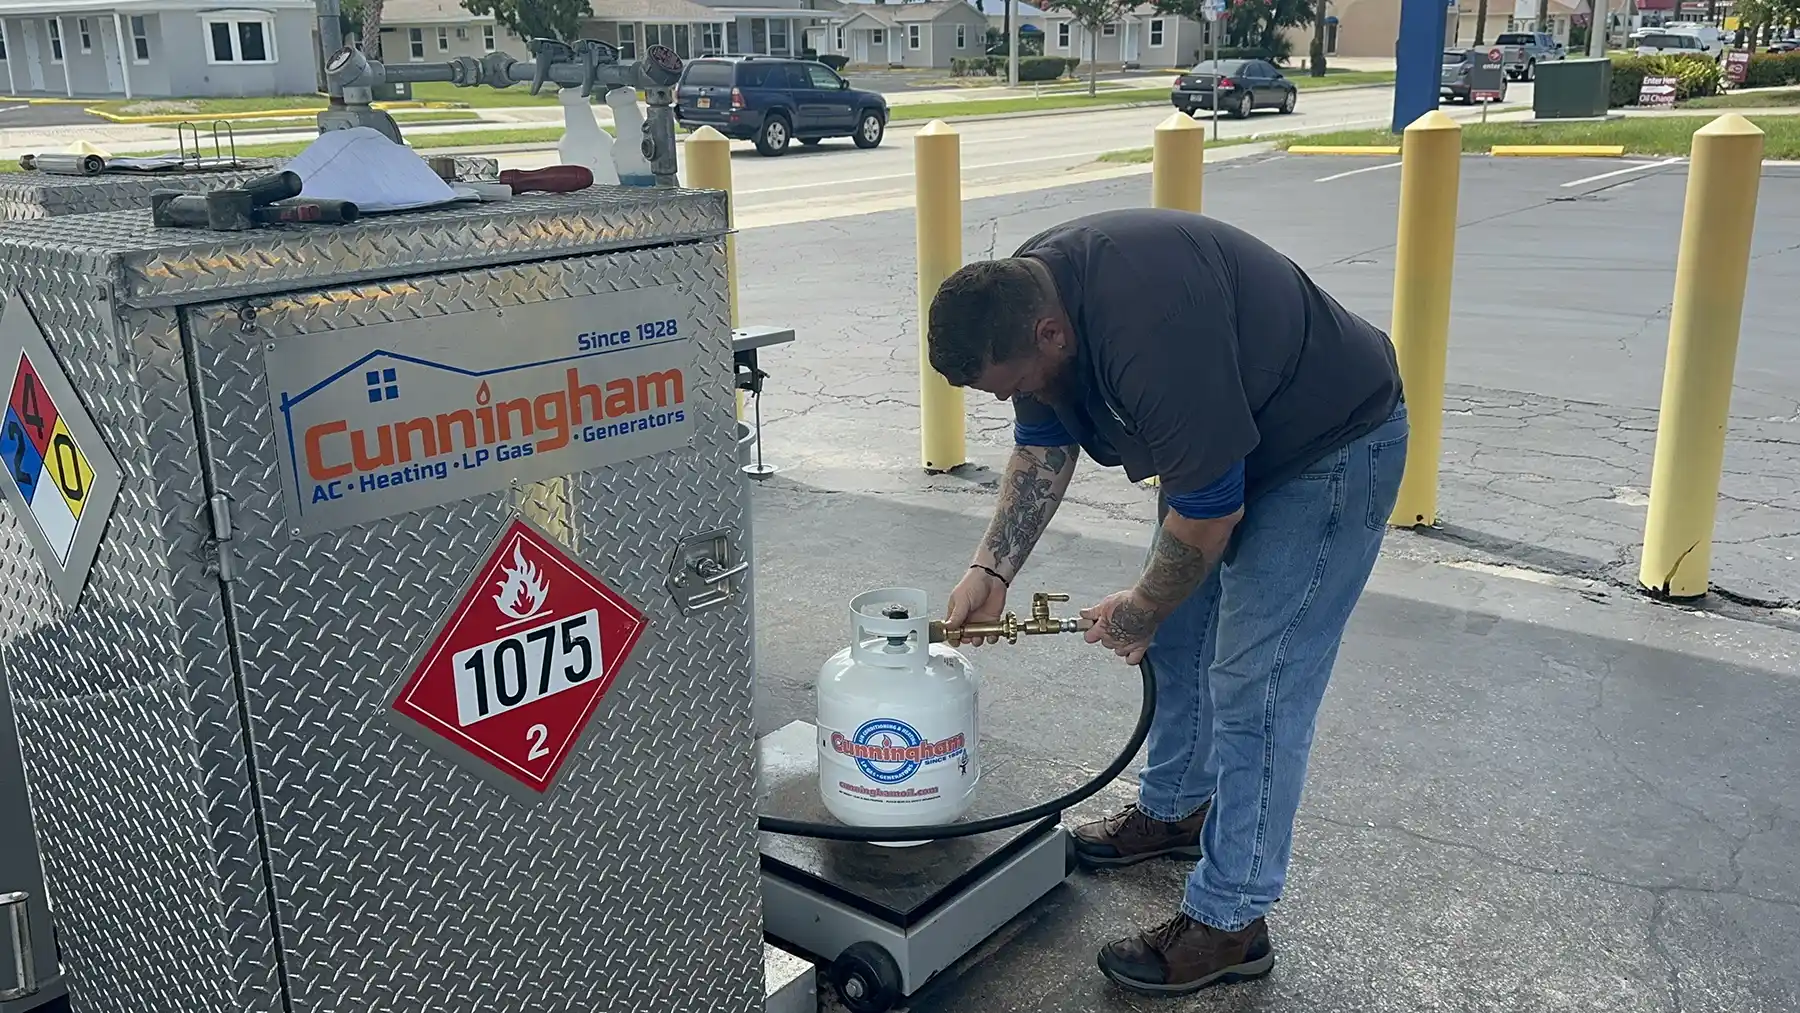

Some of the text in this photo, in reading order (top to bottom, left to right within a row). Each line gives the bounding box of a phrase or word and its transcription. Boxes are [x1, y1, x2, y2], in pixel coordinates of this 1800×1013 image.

[1643, 76, 1662, 85] Enter
[577, 319, 679, 351] Since 1928
[22, 373, 44, 440] 4
[304, 367, 685, 483] Cunningham
[8, 421, 32, 485] 2
[54, 433, 84, 502] 0
[311, 411, 686, 504] AC Heating LP Gas Generators
[464, 615, 593, 717] 1075
[526, 723, 550, 761] 2
[831, 731, 966, 763] Cunningham
[924, 756, 947, 765] SINCE
[839, 781, 939, 798] cunninghamoil.com
[879, 763, 914, 780] GENERATORS
